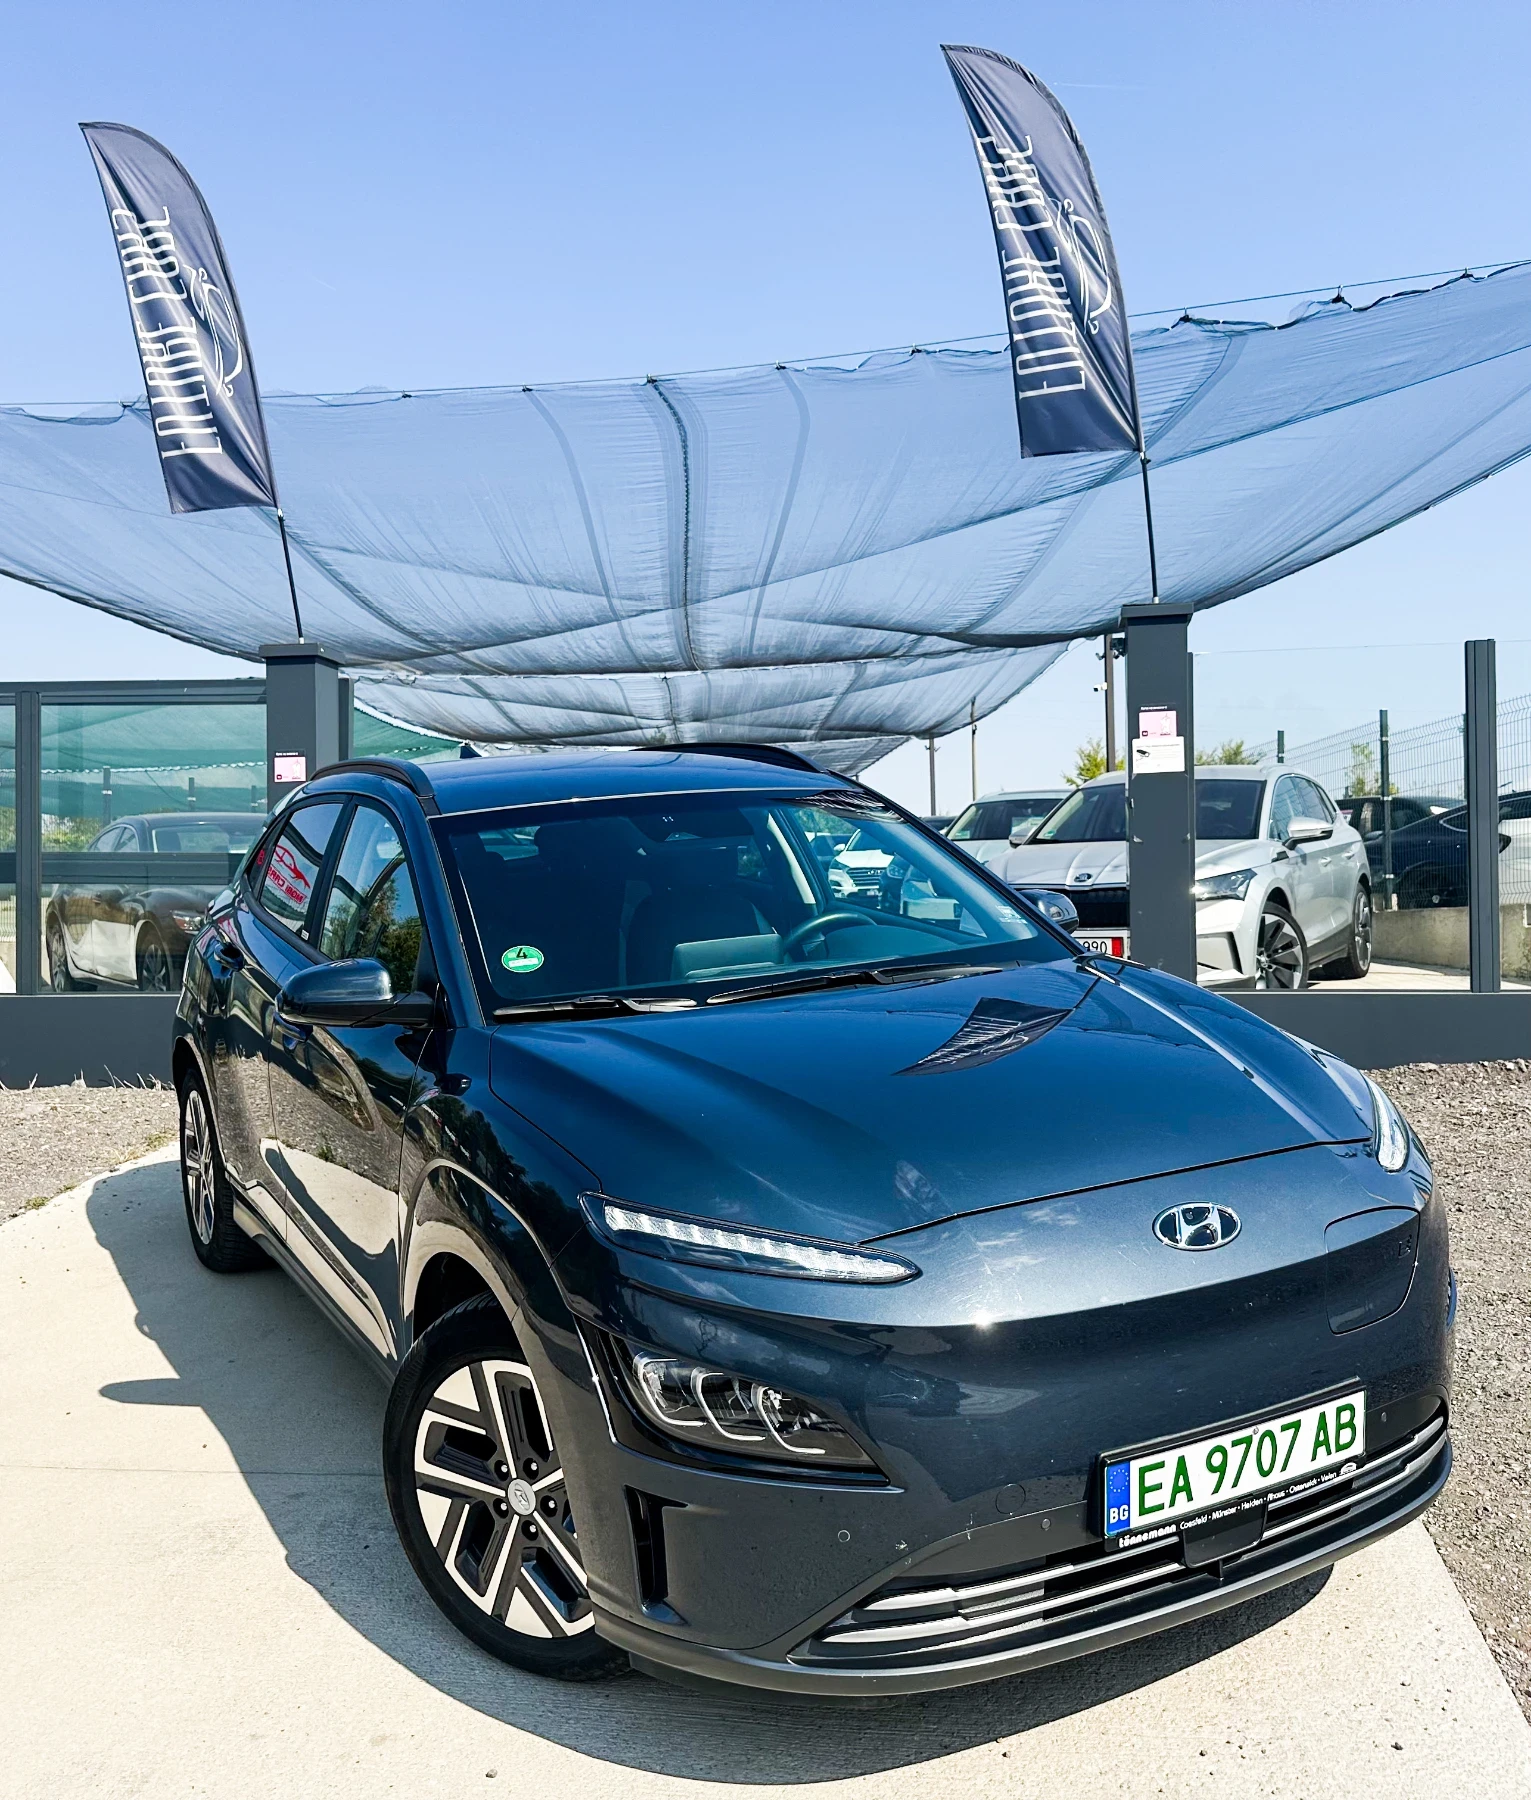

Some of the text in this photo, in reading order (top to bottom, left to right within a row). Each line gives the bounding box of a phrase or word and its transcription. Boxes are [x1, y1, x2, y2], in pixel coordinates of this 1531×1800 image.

[516, 947, 528, 959] 4
[1138, 1402, 1357, 1517] EA 9707 AB
[1109, 1504, 1129, 1524] BG
